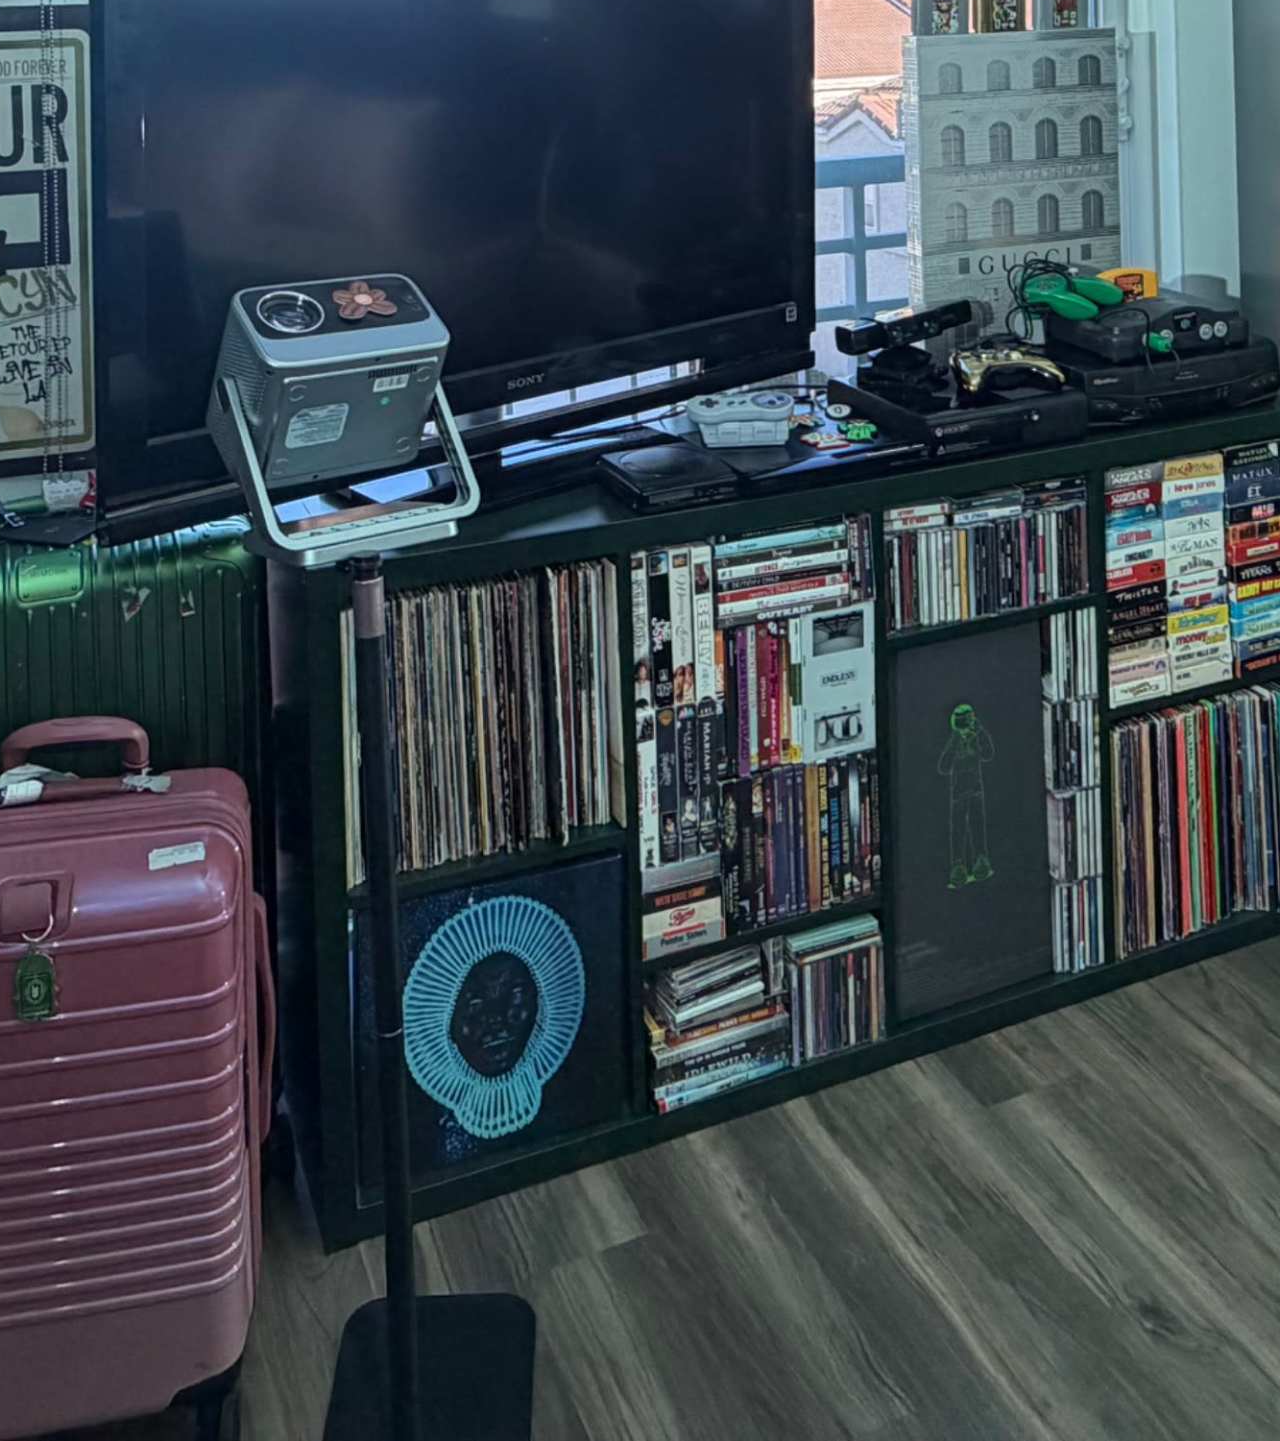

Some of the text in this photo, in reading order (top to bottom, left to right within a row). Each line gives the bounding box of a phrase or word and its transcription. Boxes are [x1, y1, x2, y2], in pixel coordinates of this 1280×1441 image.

[11, 324, 42, 341] THE
[507, 374, 545, 390] SONY
[24, 383, 48, 403] LA
[1173, 482, 1194, 493] love
[1115, 586, 1161, 603] TWISTER
[757, 605, 814, 620] OUTKAST
[696, 596, 712, 665] BELLY
[821, 671, 857, 684] ENDLESS
